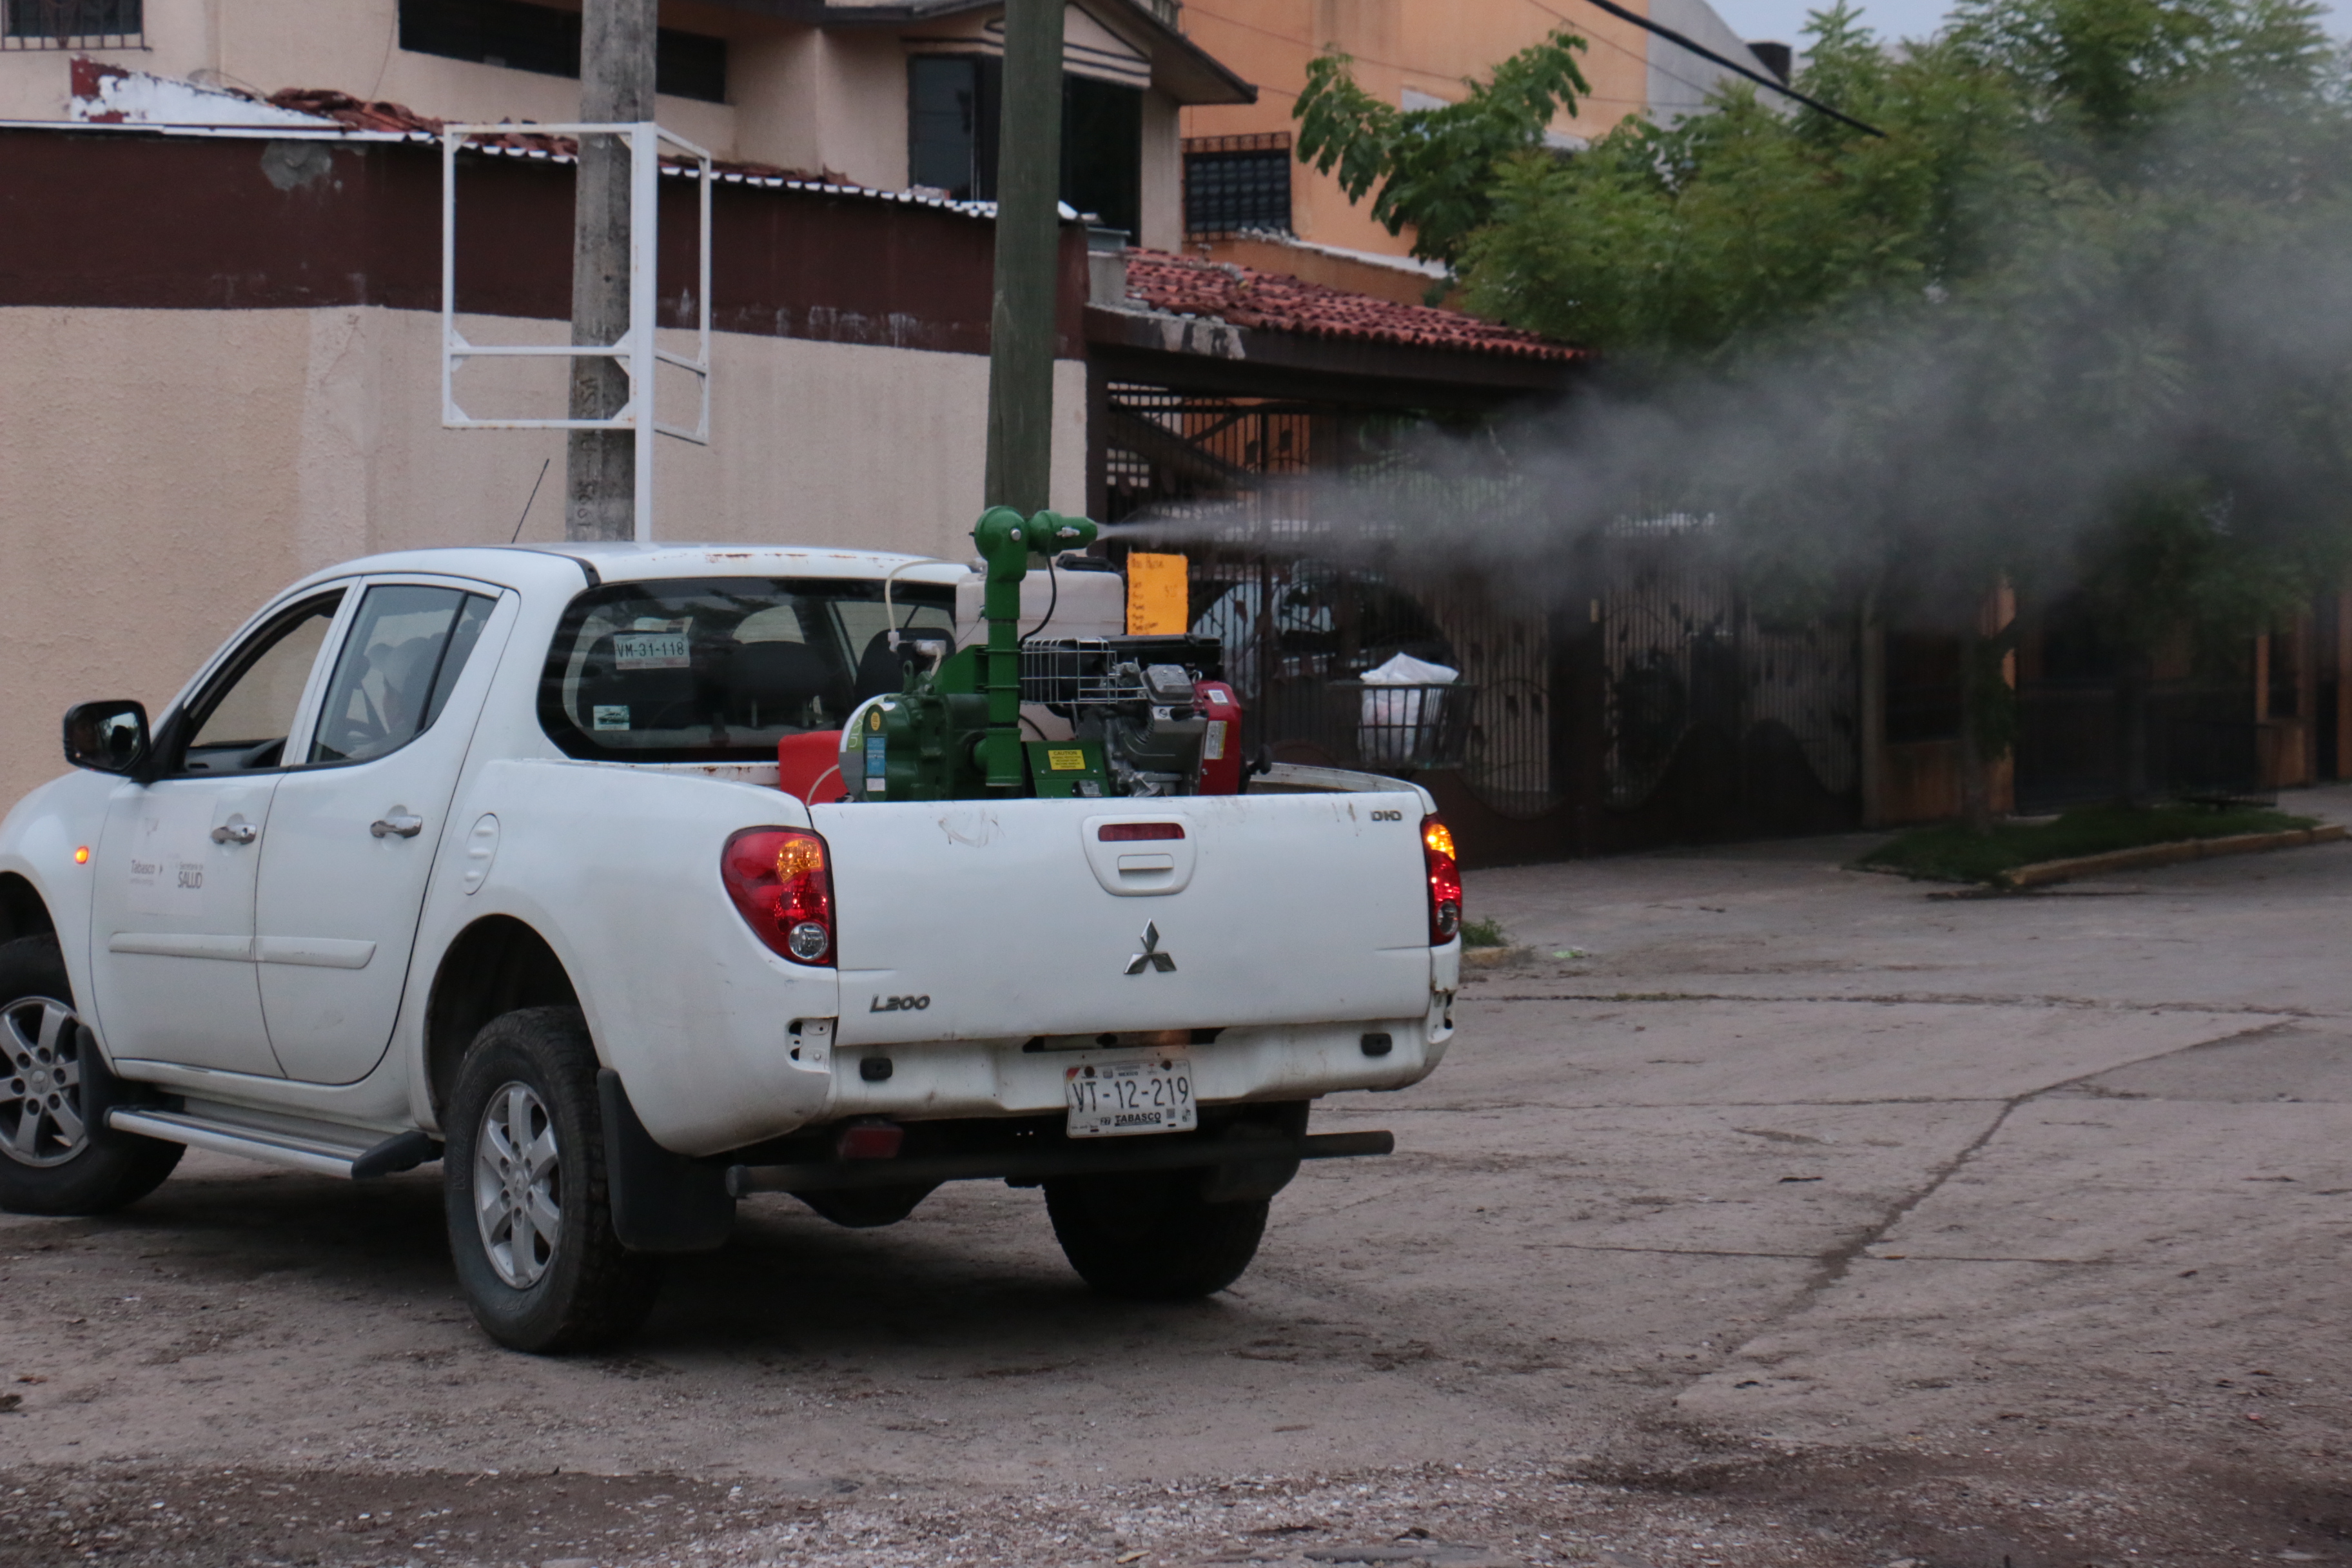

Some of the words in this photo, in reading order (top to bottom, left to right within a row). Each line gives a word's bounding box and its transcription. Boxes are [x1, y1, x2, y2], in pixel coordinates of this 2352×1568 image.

[616, 642, 685, 658] VM-31-118
[177, 871, 203, 889] SALUD
[869, 994, 930, 1012] L200
[1072, 1076, 1189, 1113] VT-12-219
[1114, 1112, 1161, 1123] TABASCO
